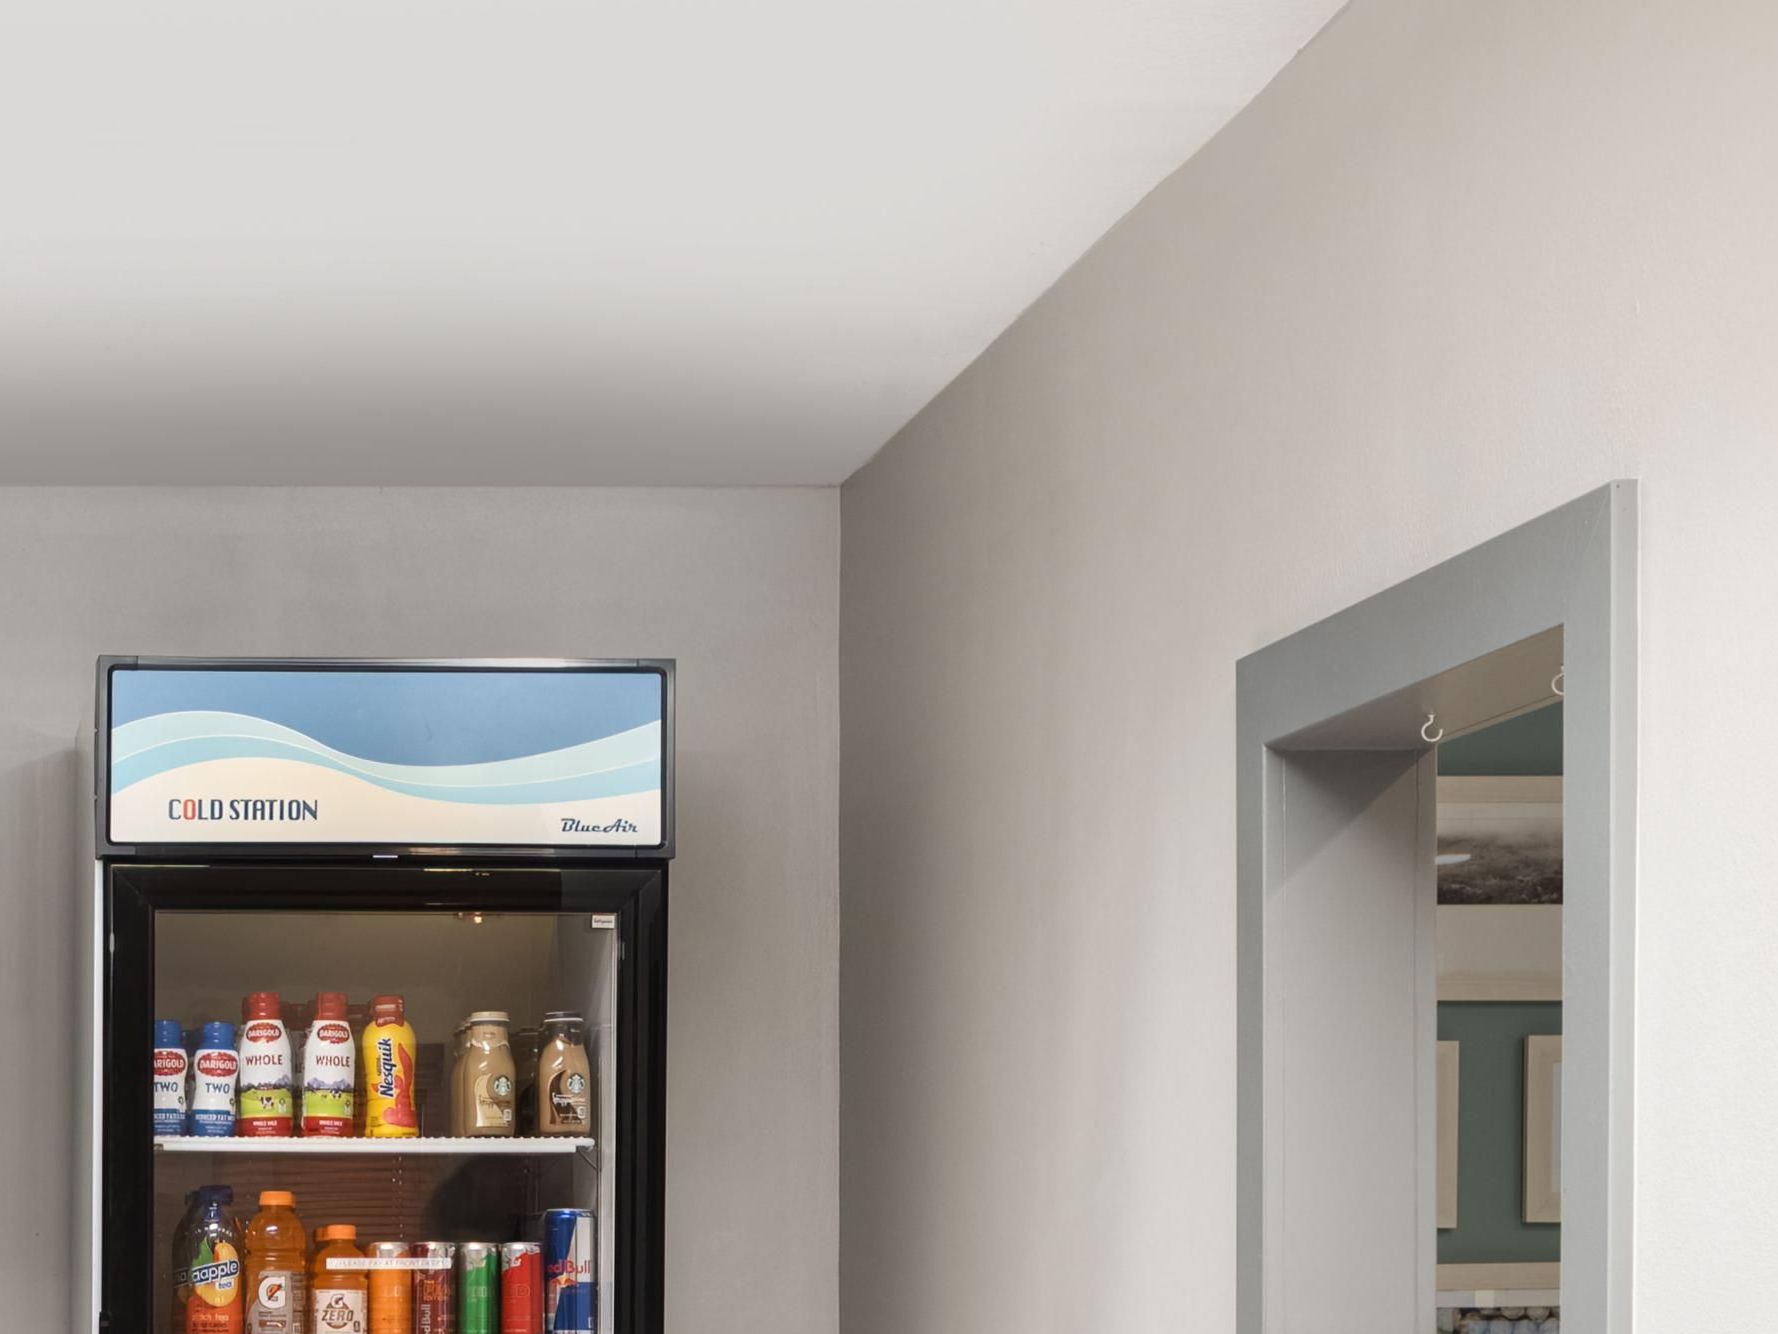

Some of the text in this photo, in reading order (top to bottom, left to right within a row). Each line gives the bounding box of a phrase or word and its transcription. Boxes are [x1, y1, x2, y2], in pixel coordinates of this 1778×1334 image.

[168, 799, 318, 821] COLD STATION
[248, 1029, 280, 1038] DARIGOLD
[319, 1029, 349, 1039] DARIGOLD
[154, 1057, 185, 1070] ARIGOLD
[199, 1058, 237, 1070] DARIGOLD
[245, 1054, 284, 1066] WHOLE
[316, 1055, 351, 1068] WHOLE
[379, 1037, 397, 1098] Nesquik
[205, 1082, 231, 1094] TWO
[218, 1281, 233, 1289] tea
[258, 1277, 286, 1309] G
[321, 1309, 354, 1322] ZERO
